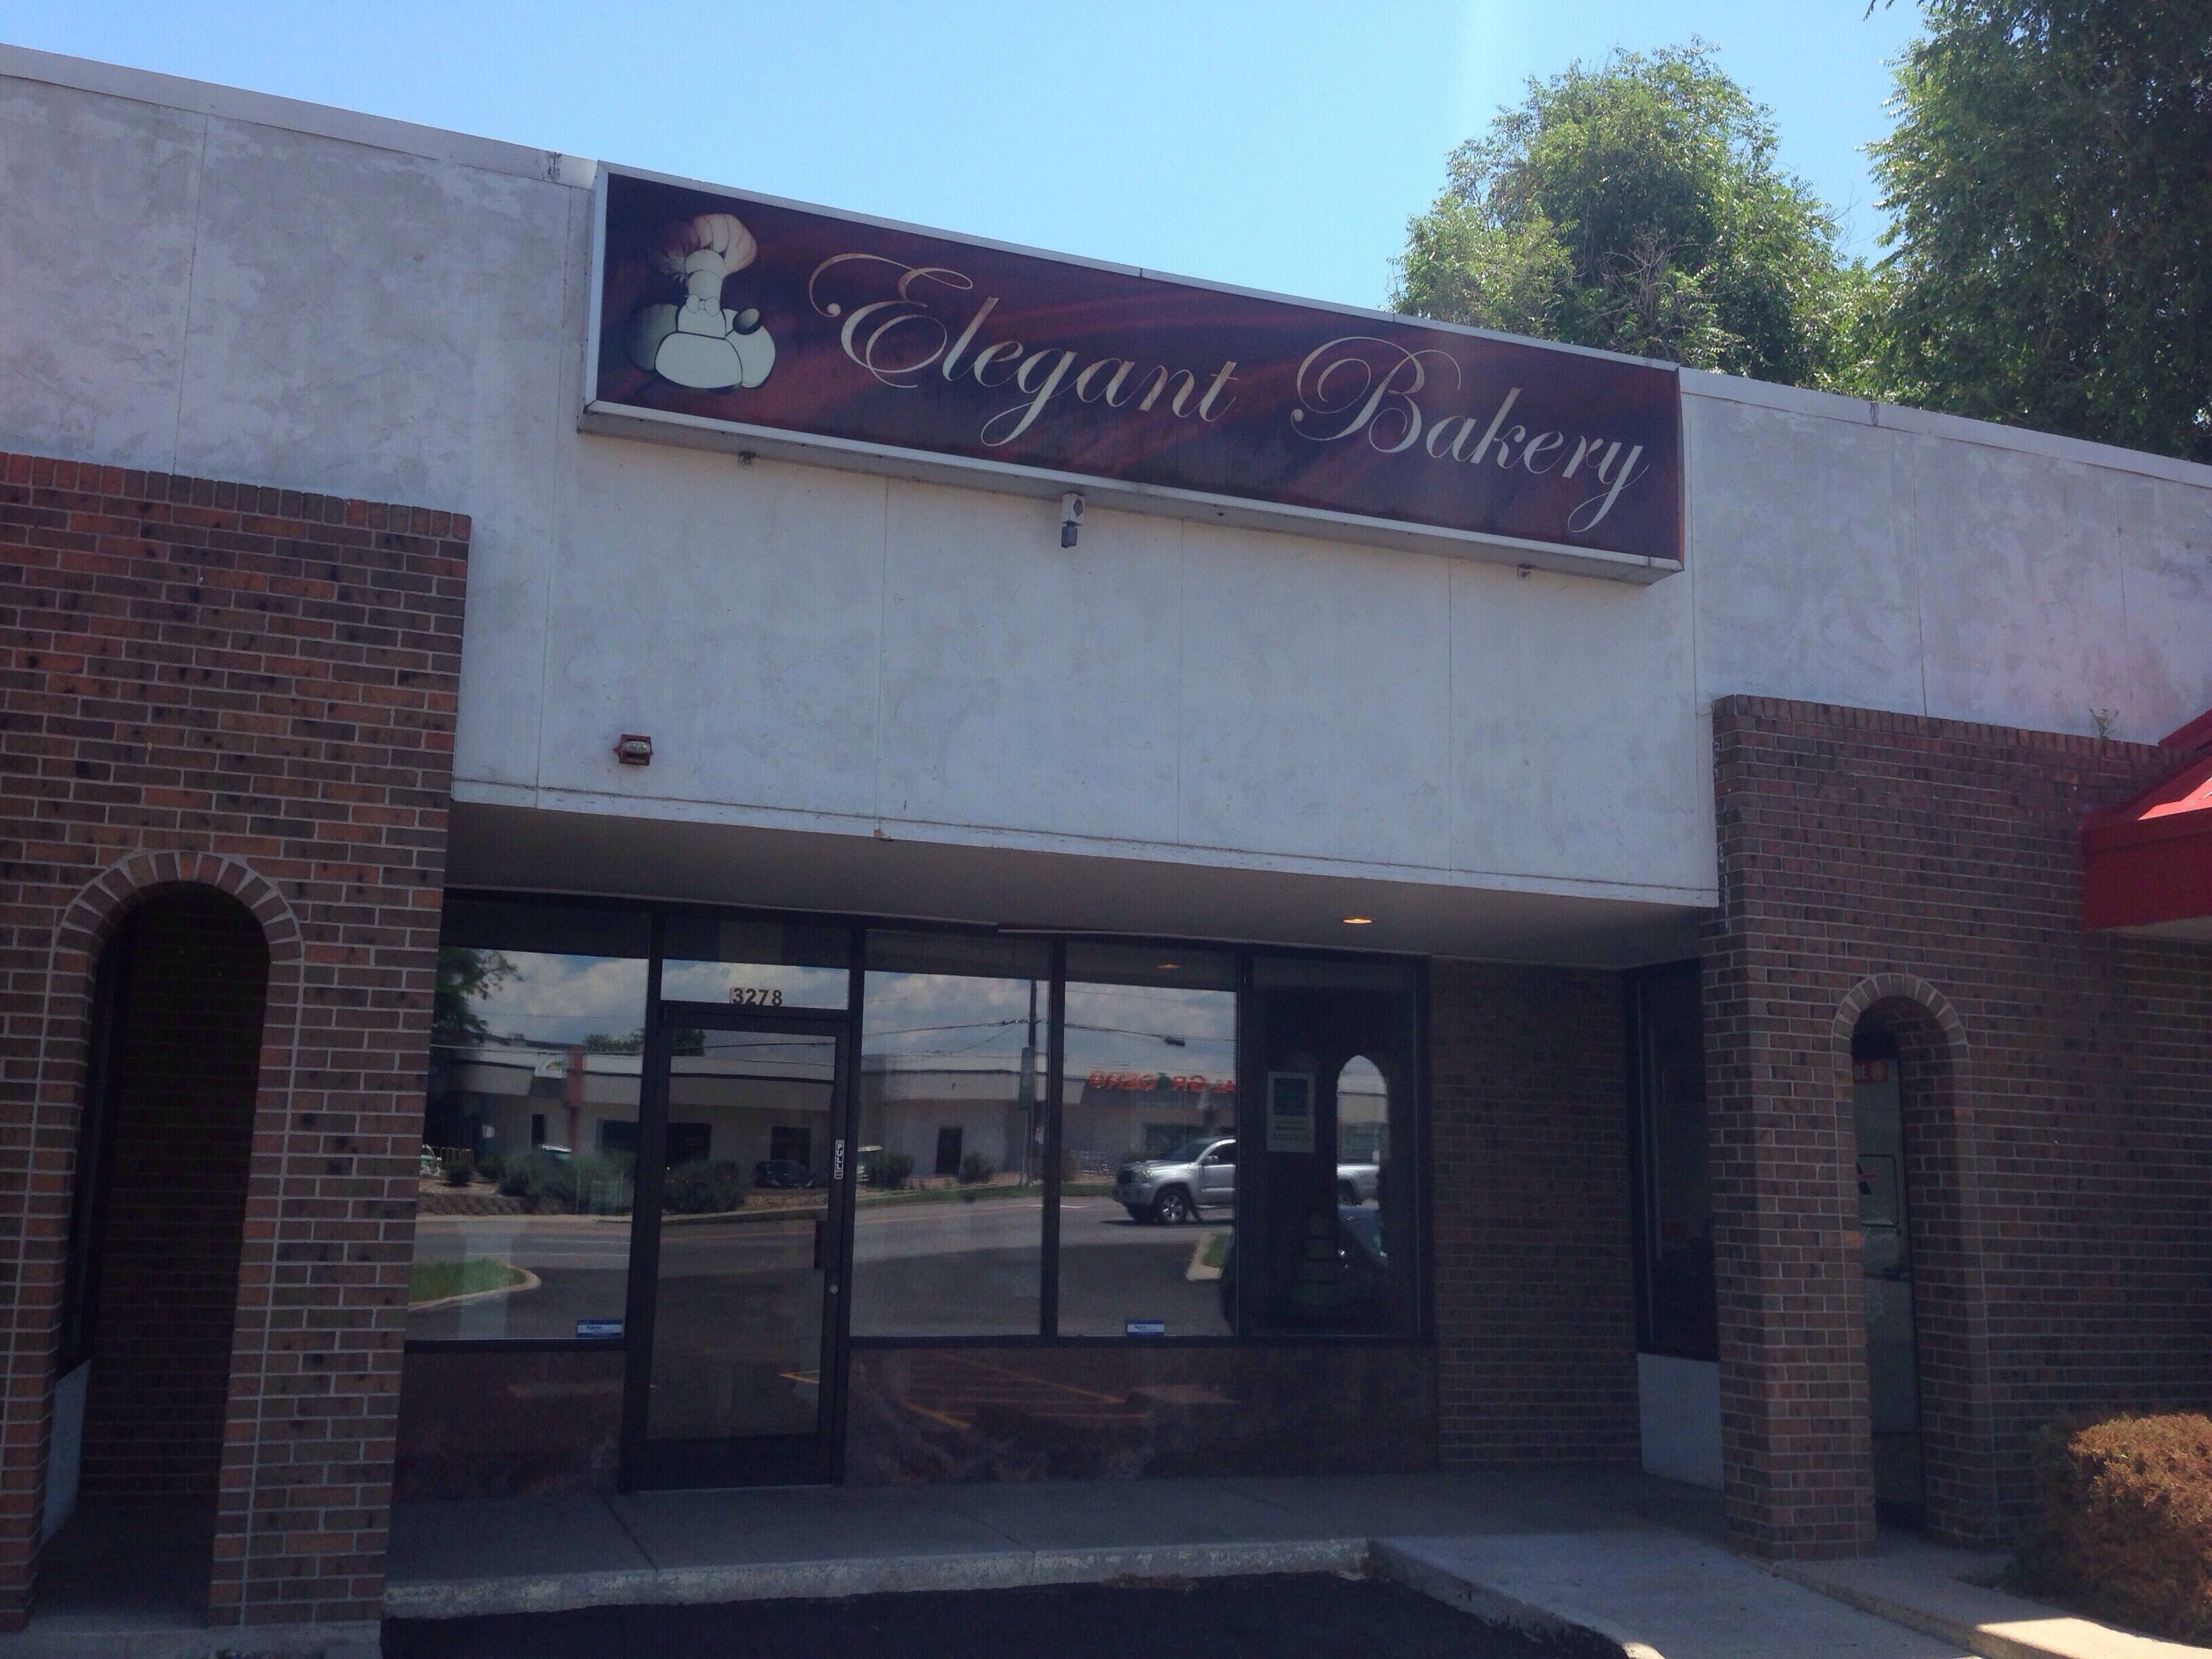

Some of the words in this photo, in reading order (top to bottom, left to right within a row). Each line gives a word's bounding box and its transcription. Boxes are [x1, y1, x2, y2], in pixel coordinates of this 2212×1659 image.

[808, 253, 1237, 447] Elegant
[1291, 336, 1650, 533] Bakery
[733, 987, 783, 1006] 3278
